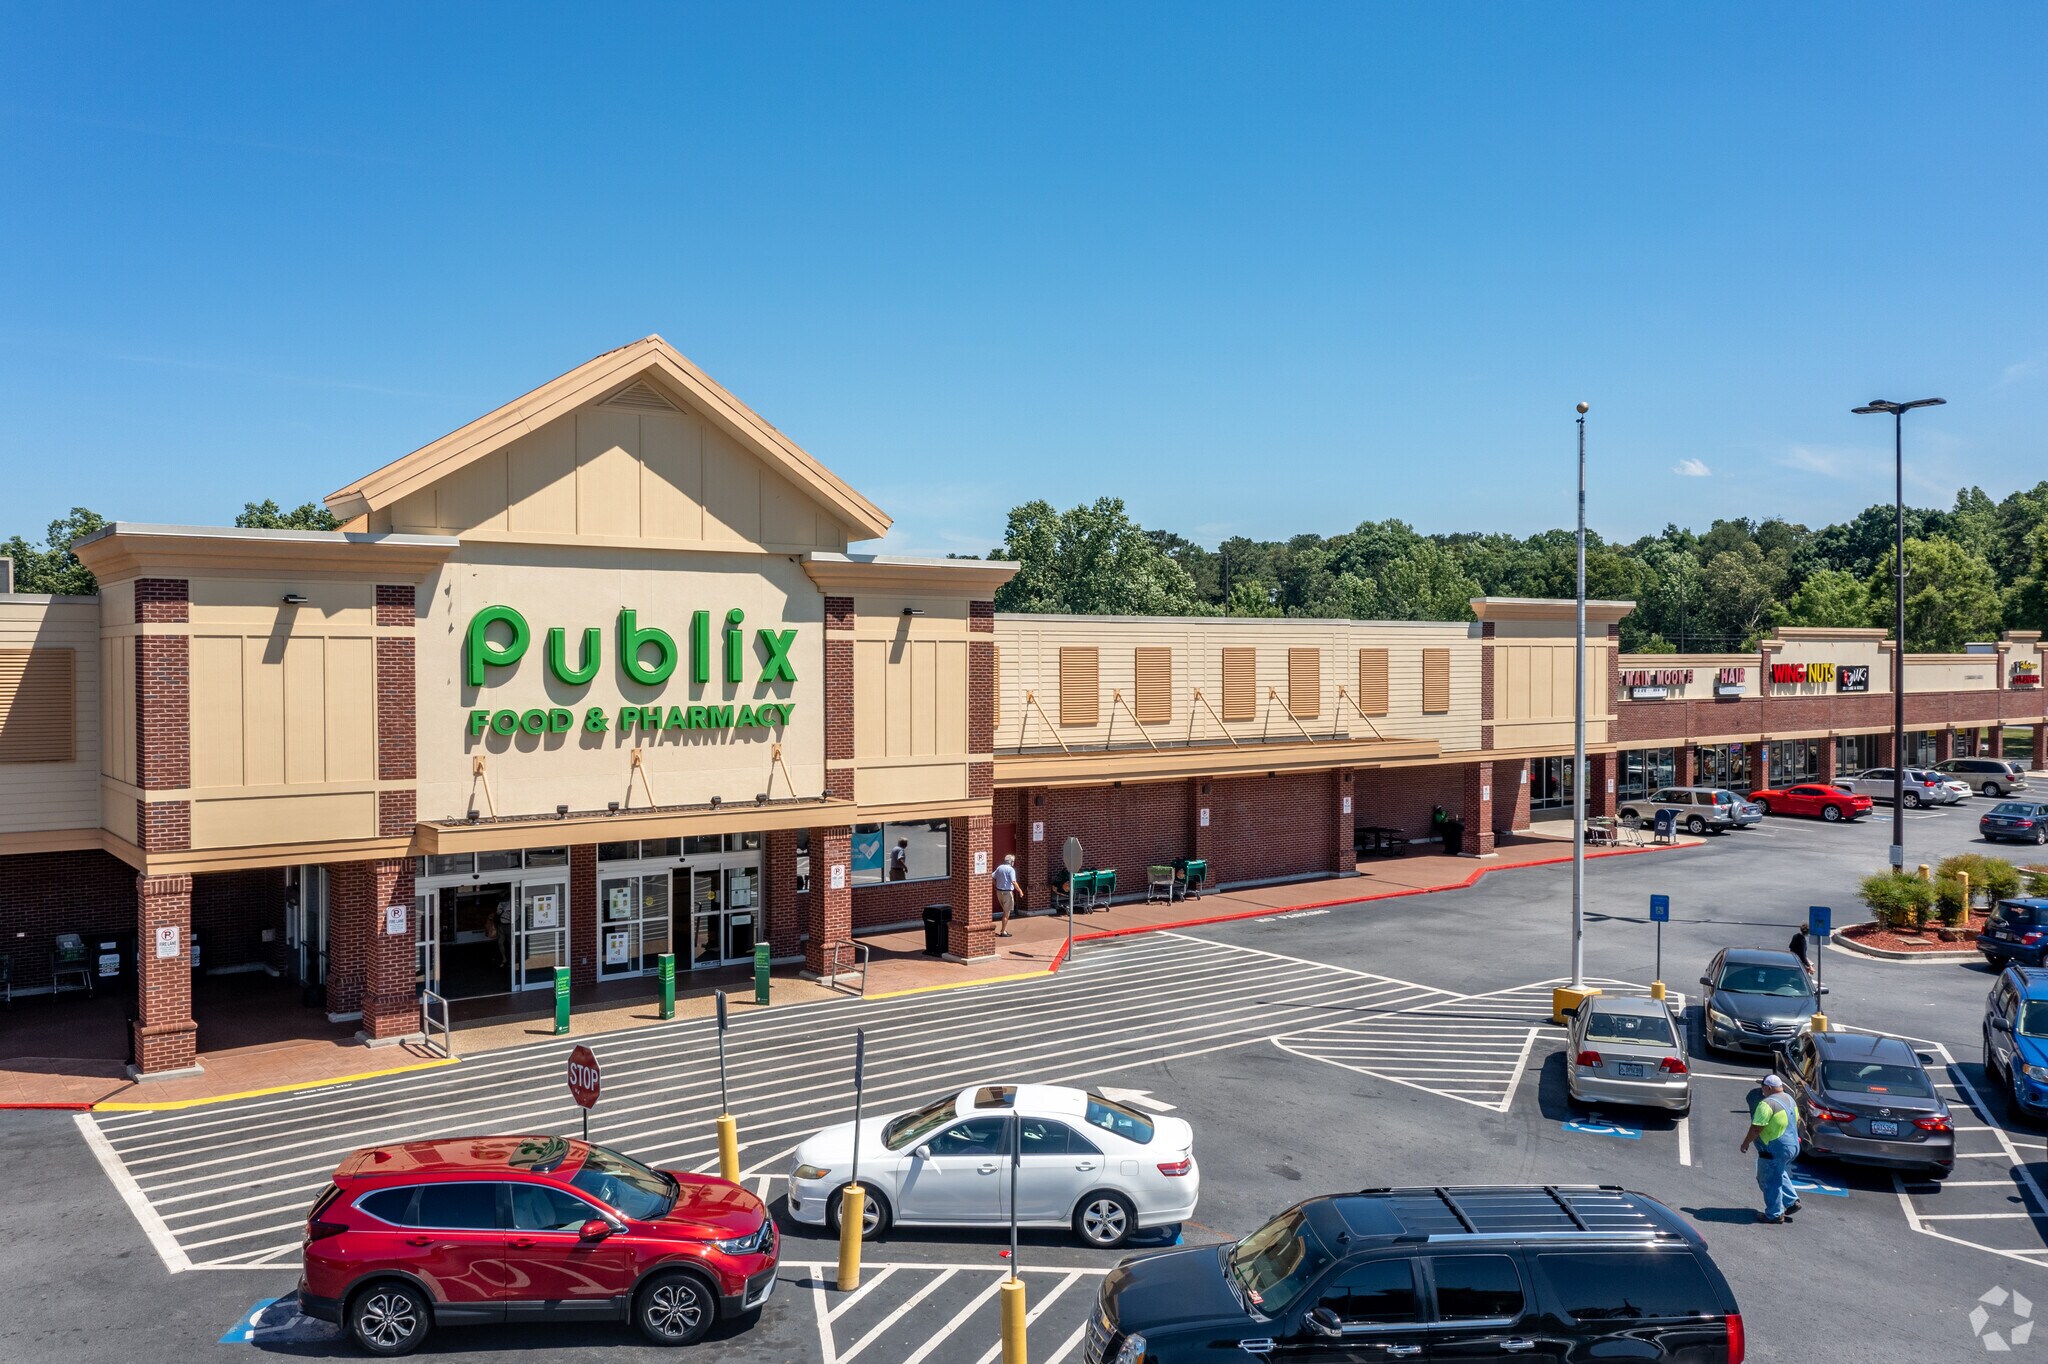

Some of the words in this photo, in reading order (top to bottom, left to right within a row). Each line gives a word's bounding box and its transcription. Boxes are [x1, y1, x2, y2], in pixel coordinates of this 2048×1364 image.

[468, 605, 798, 687] Publix
[1625, 670, 1651, 686] MAIN
[1655, 669, 1684, 685] MOON
[1720, 668, 1745, 684] HAIR
[1772, 663, 1806, 683] WING
[1807, 663, 1835, 683] NUTS
[470, 708, 573, 736] FOOD
[585, 705, 609, 734] &
[620, 703, 795, 731] PHARMACY
[570, 1062, 599, 1091] STOP
